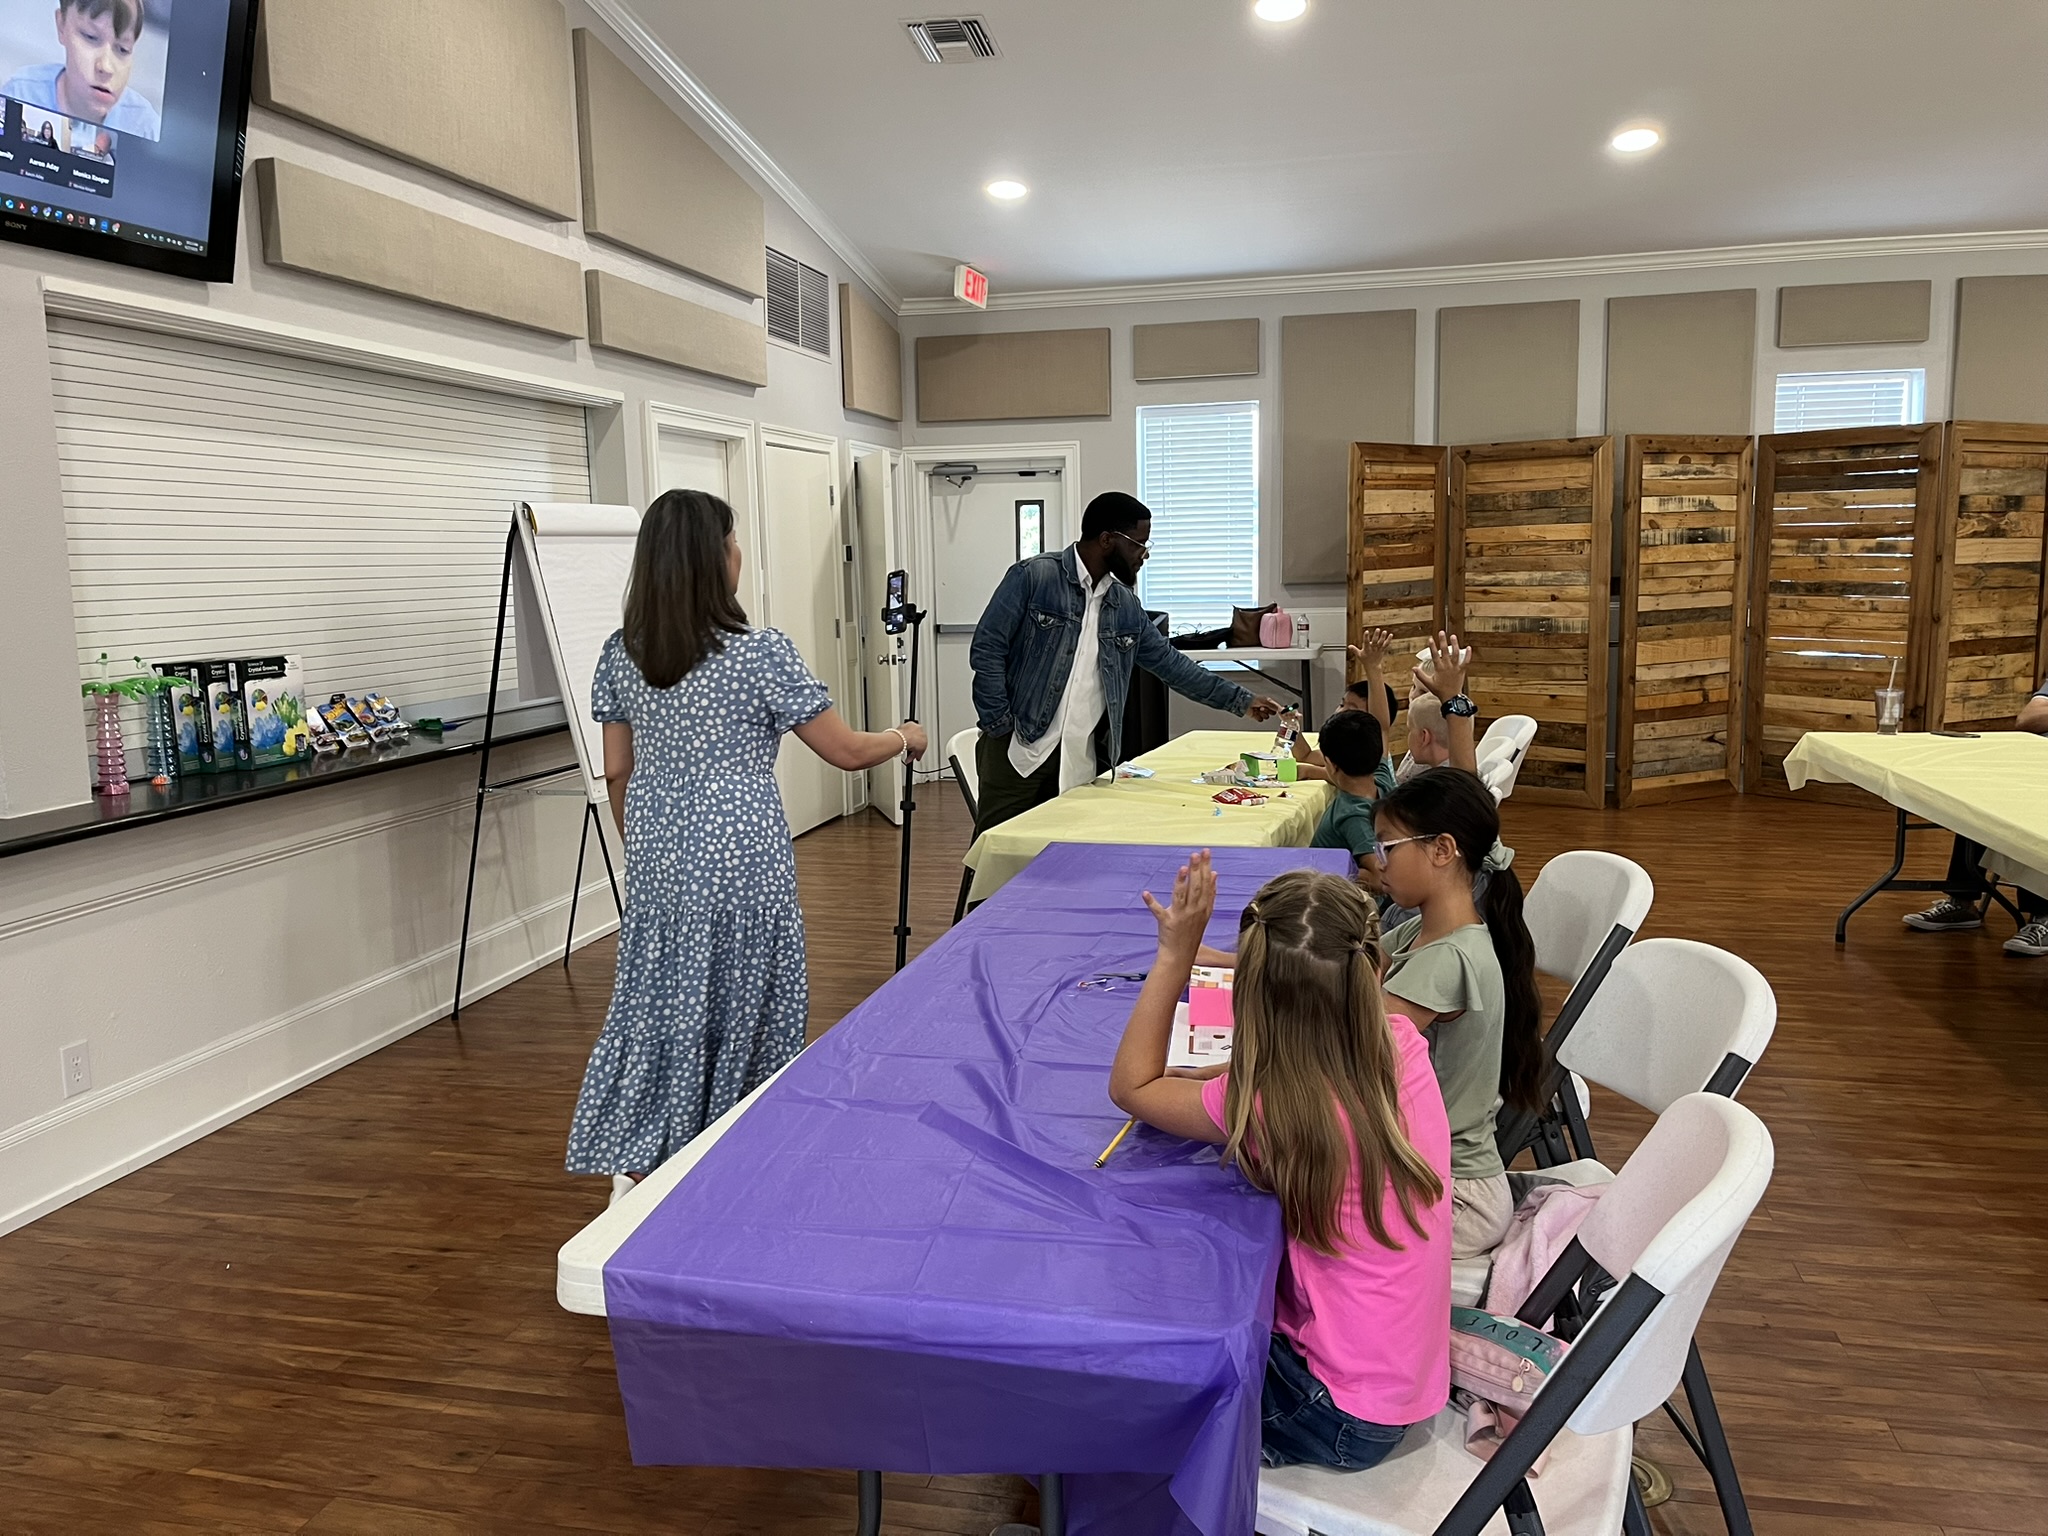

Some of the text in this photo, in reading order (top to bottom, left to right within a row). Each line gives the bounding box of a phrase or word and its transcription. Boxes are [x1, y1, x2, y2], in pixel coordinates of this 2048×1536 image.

[5, 220, 27, 231] SONY
[965, 268, 987, 305] EXIT
[1466, 1315, 1543, 1352] LOVE
